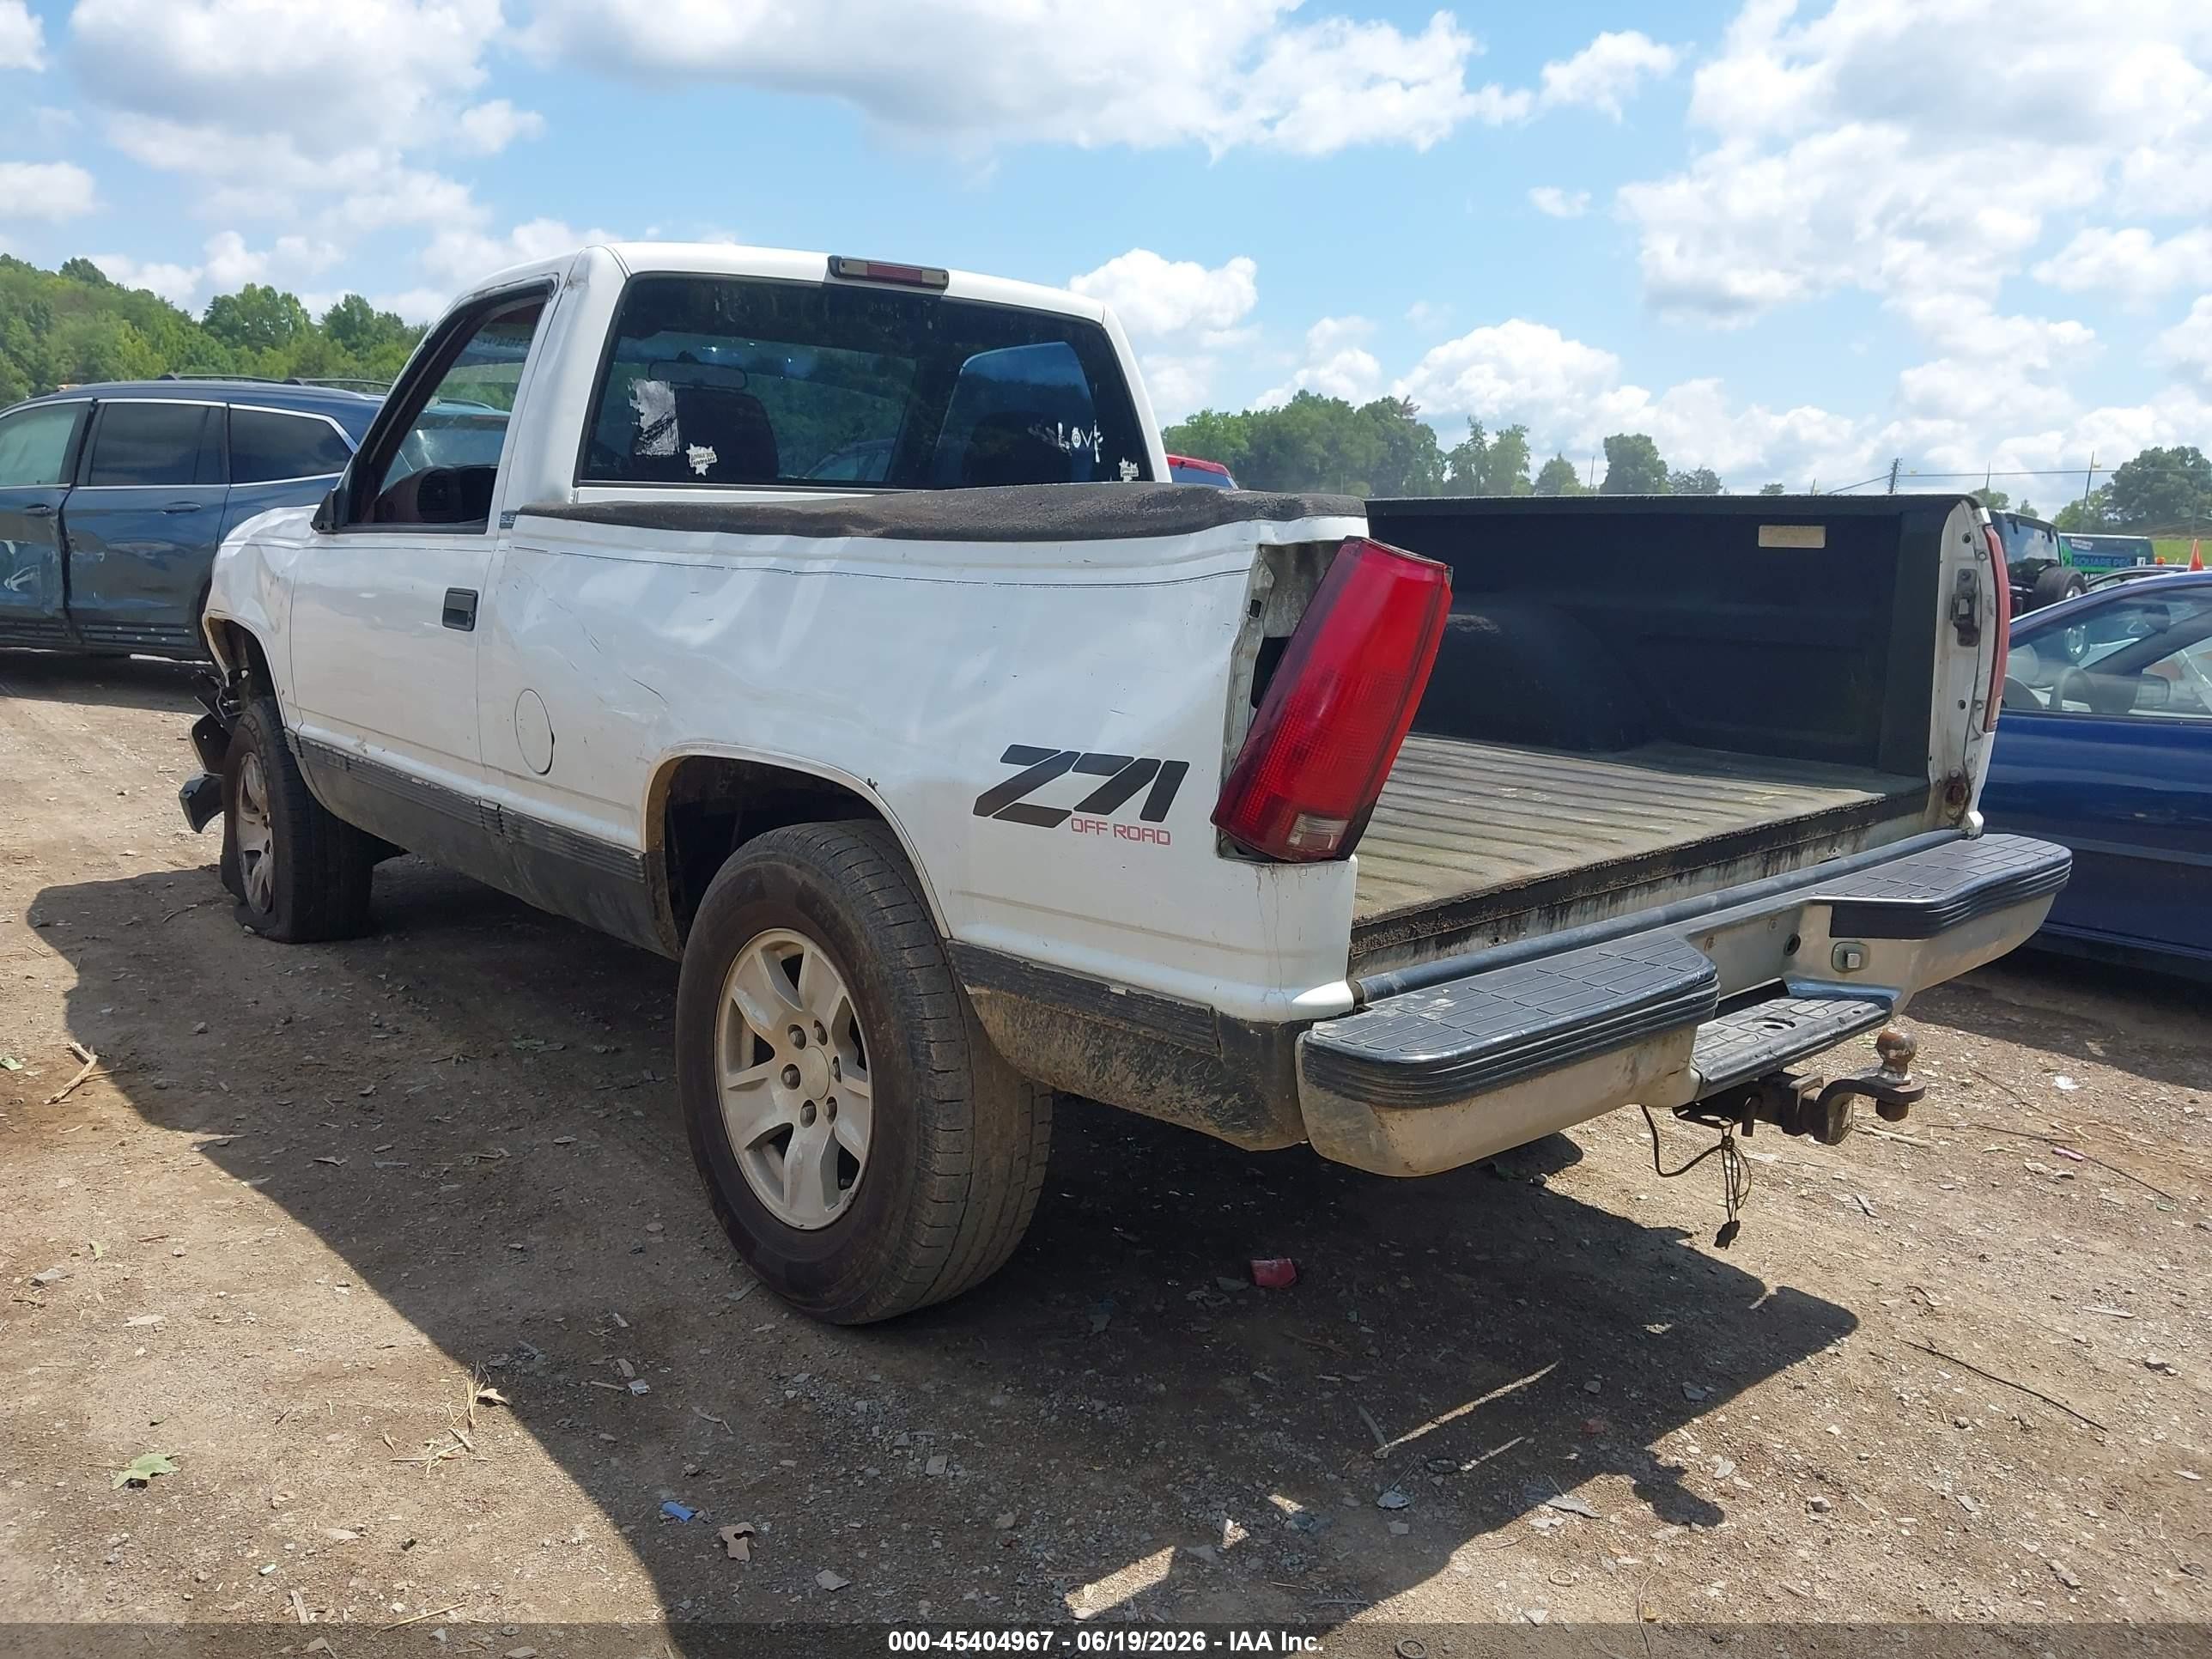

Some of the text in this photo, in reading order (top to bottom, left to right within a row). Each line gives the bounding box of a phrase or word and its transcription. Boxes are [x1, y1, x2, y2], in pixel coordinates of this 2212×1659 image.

[972, 744, 1190, 829] Z71
[1071, 817, 1171, 846] OFF ROAD
